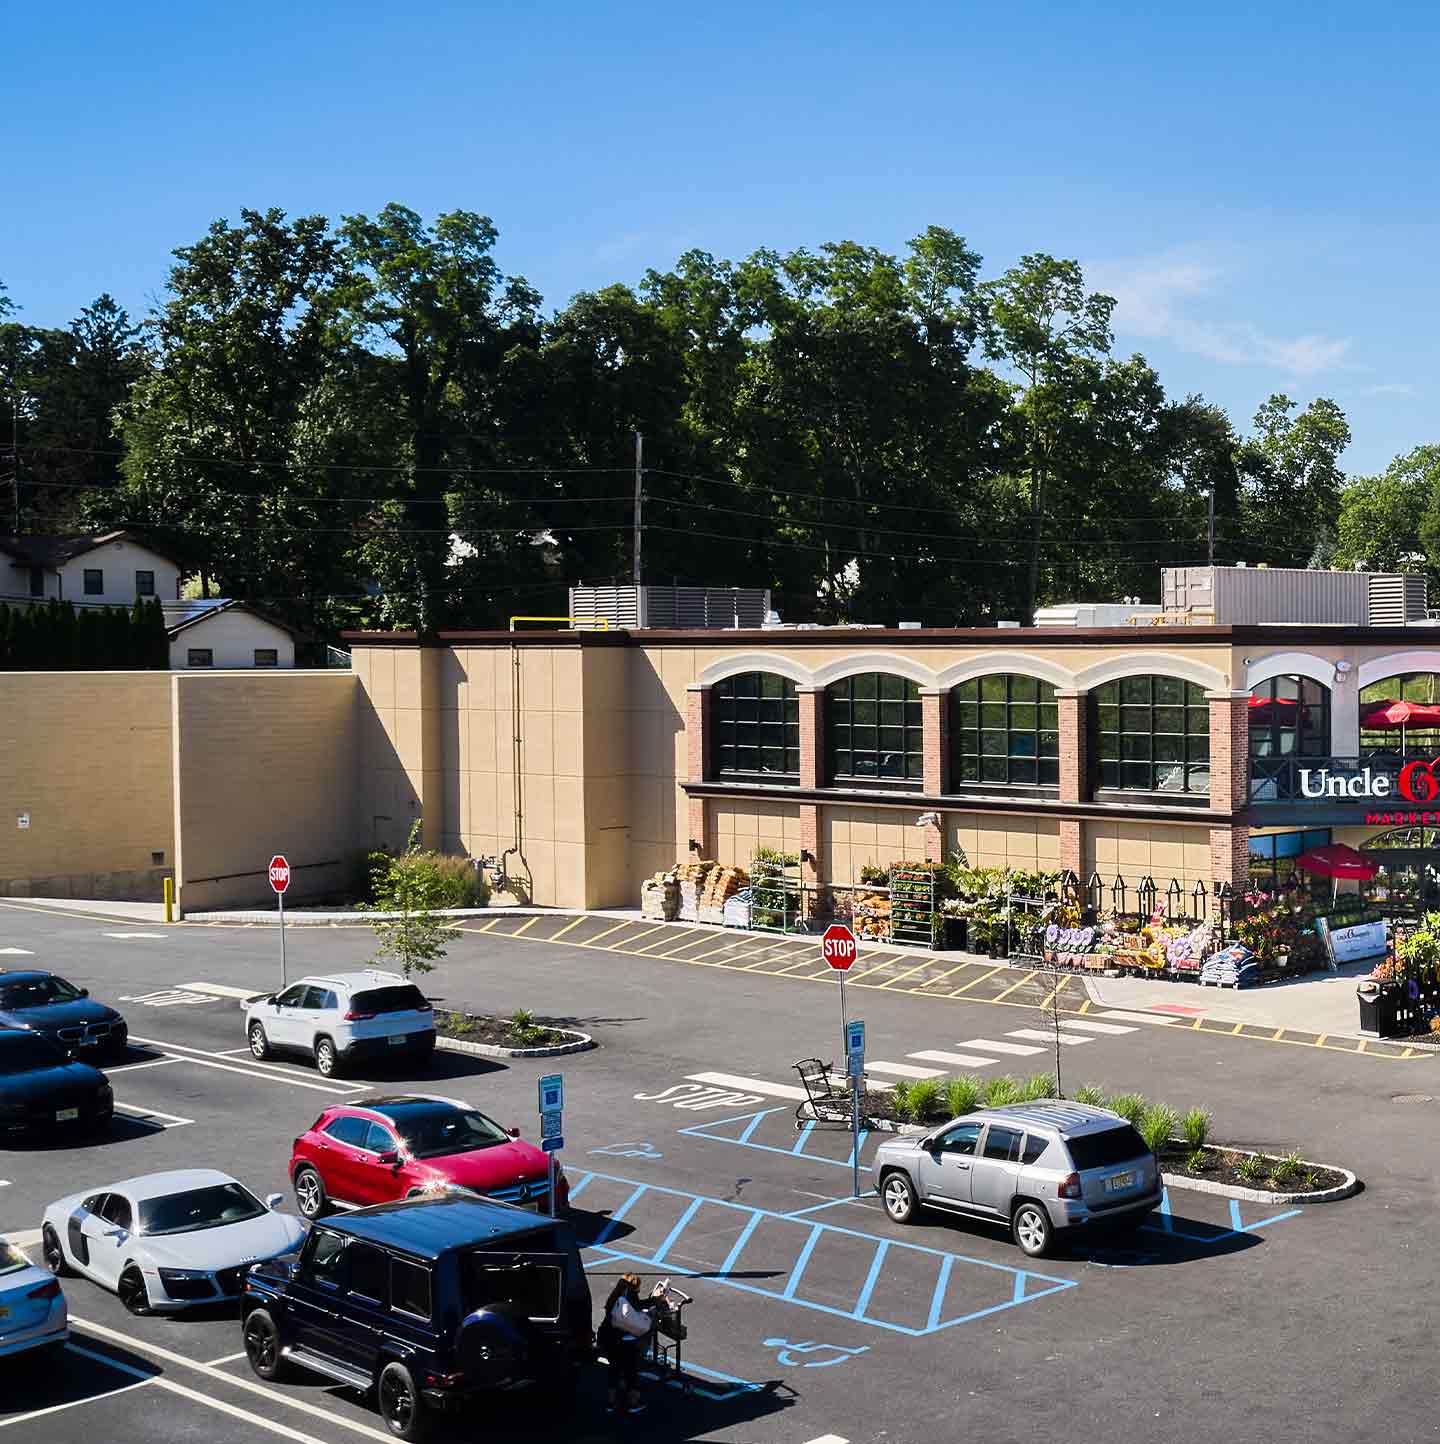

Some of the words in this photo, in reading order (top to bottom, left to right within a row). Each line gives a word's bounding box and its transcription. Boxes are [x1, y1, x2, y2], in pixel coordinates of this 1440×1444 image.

[1298, 768, 1389, 797] Uncle
[270, 867, 288, 881] STOP
[824, 938, 855, 957] STOP
[632, 1084, 766, 1111] STOP
